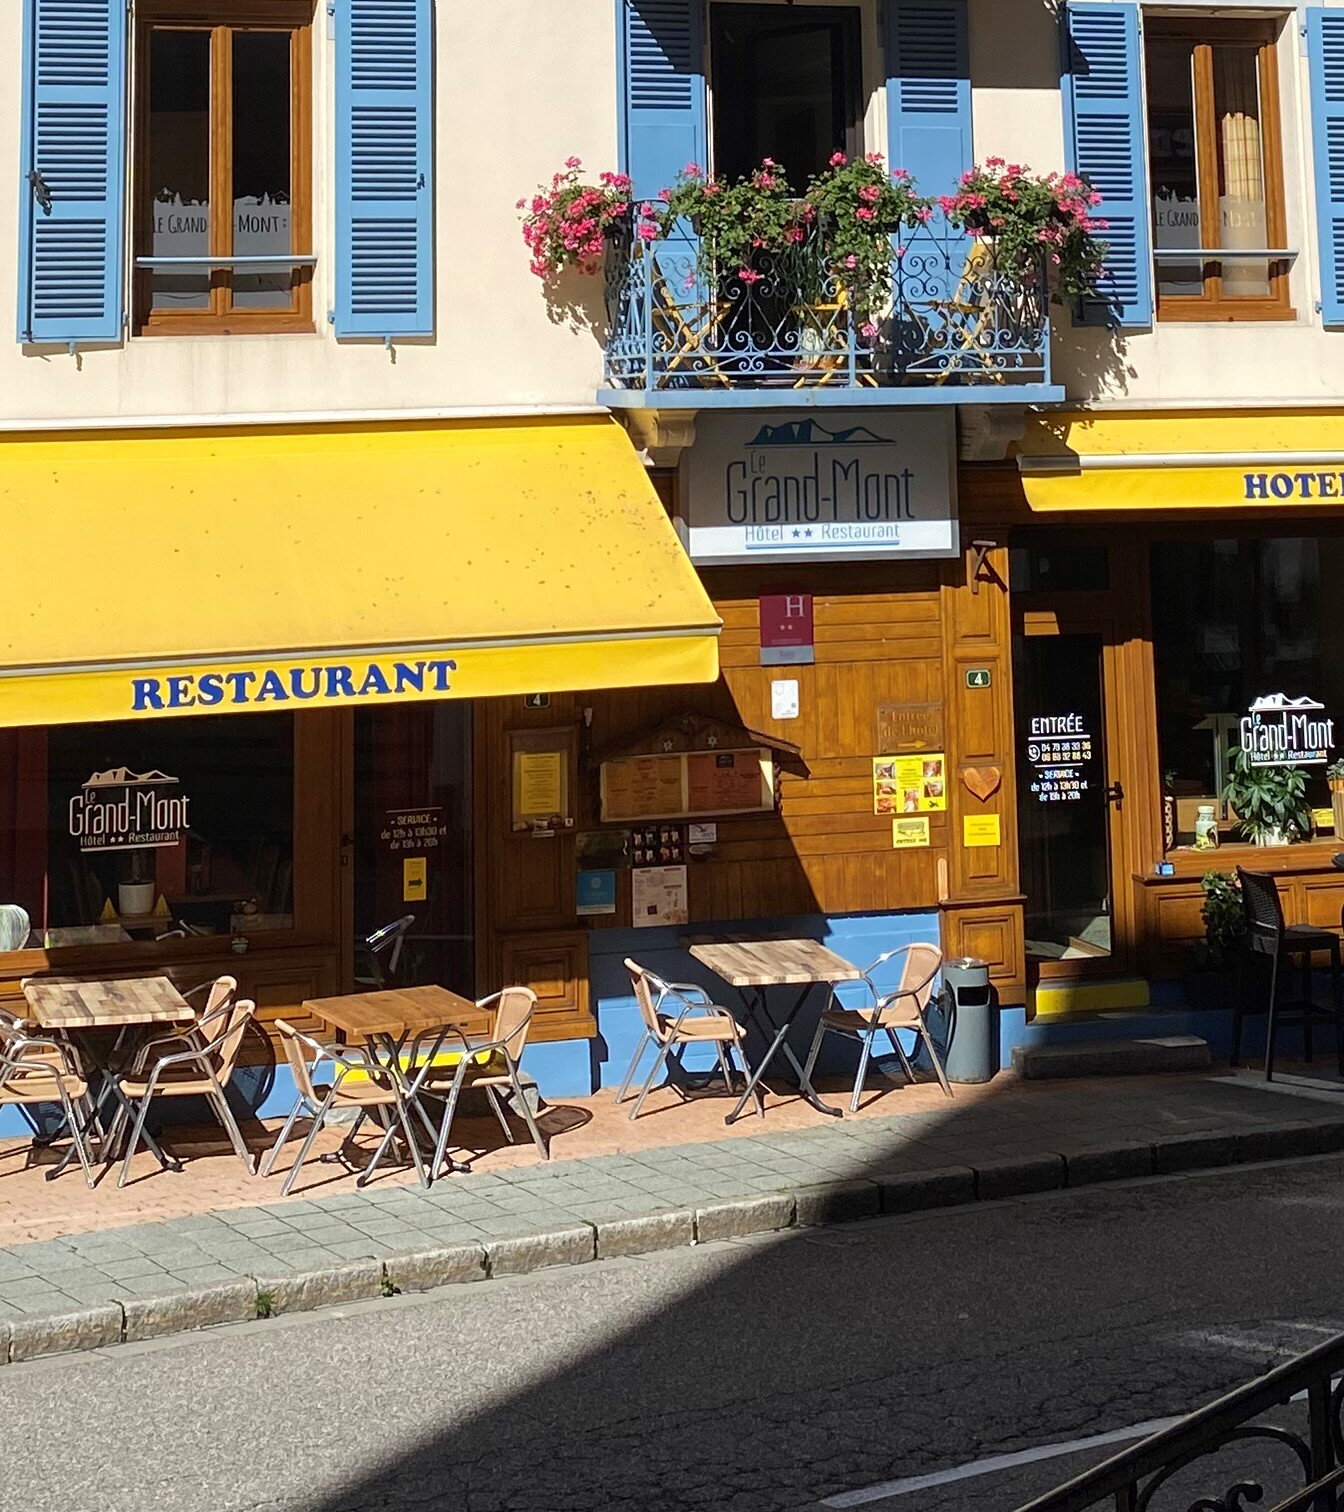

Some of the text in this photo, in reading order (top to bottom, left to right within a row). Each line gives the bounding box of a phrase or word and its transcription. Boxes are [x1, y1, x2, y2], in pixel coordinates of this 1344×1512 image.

[153, 214, 279, 234] LE GRAND MONT
[1155, 210, 1163, 225] LE
[1167, 210, 1198, 226] GRAND
[750, 450, 766, 474] Le
[726, 452, 915, 524] Grand-Mont
[745, 524, 900, 542] Hôtel Restaurant
[785, 595, 805, 618] H
[131, 659, 458, 710] RESTAURANT
[1031, 713, 1083, 734] ENTRÉE
[1252, 711, 1261, 725] Le
[1240, 711, 1335, 752] Grand-Mont
[1288, 749, 1327, 759] Restaurant
[1031, 782, 1040, 791] de
[85, 788, 96, 804] Le
[70, 788, 190, 836] Grand-Mont
[397, 814, 431, 825] SERVICE
[80, 831, 179, 846] Hôtel Restaurant
[381, 829, 390, 840] de
[439, 826, 447, 835] et
